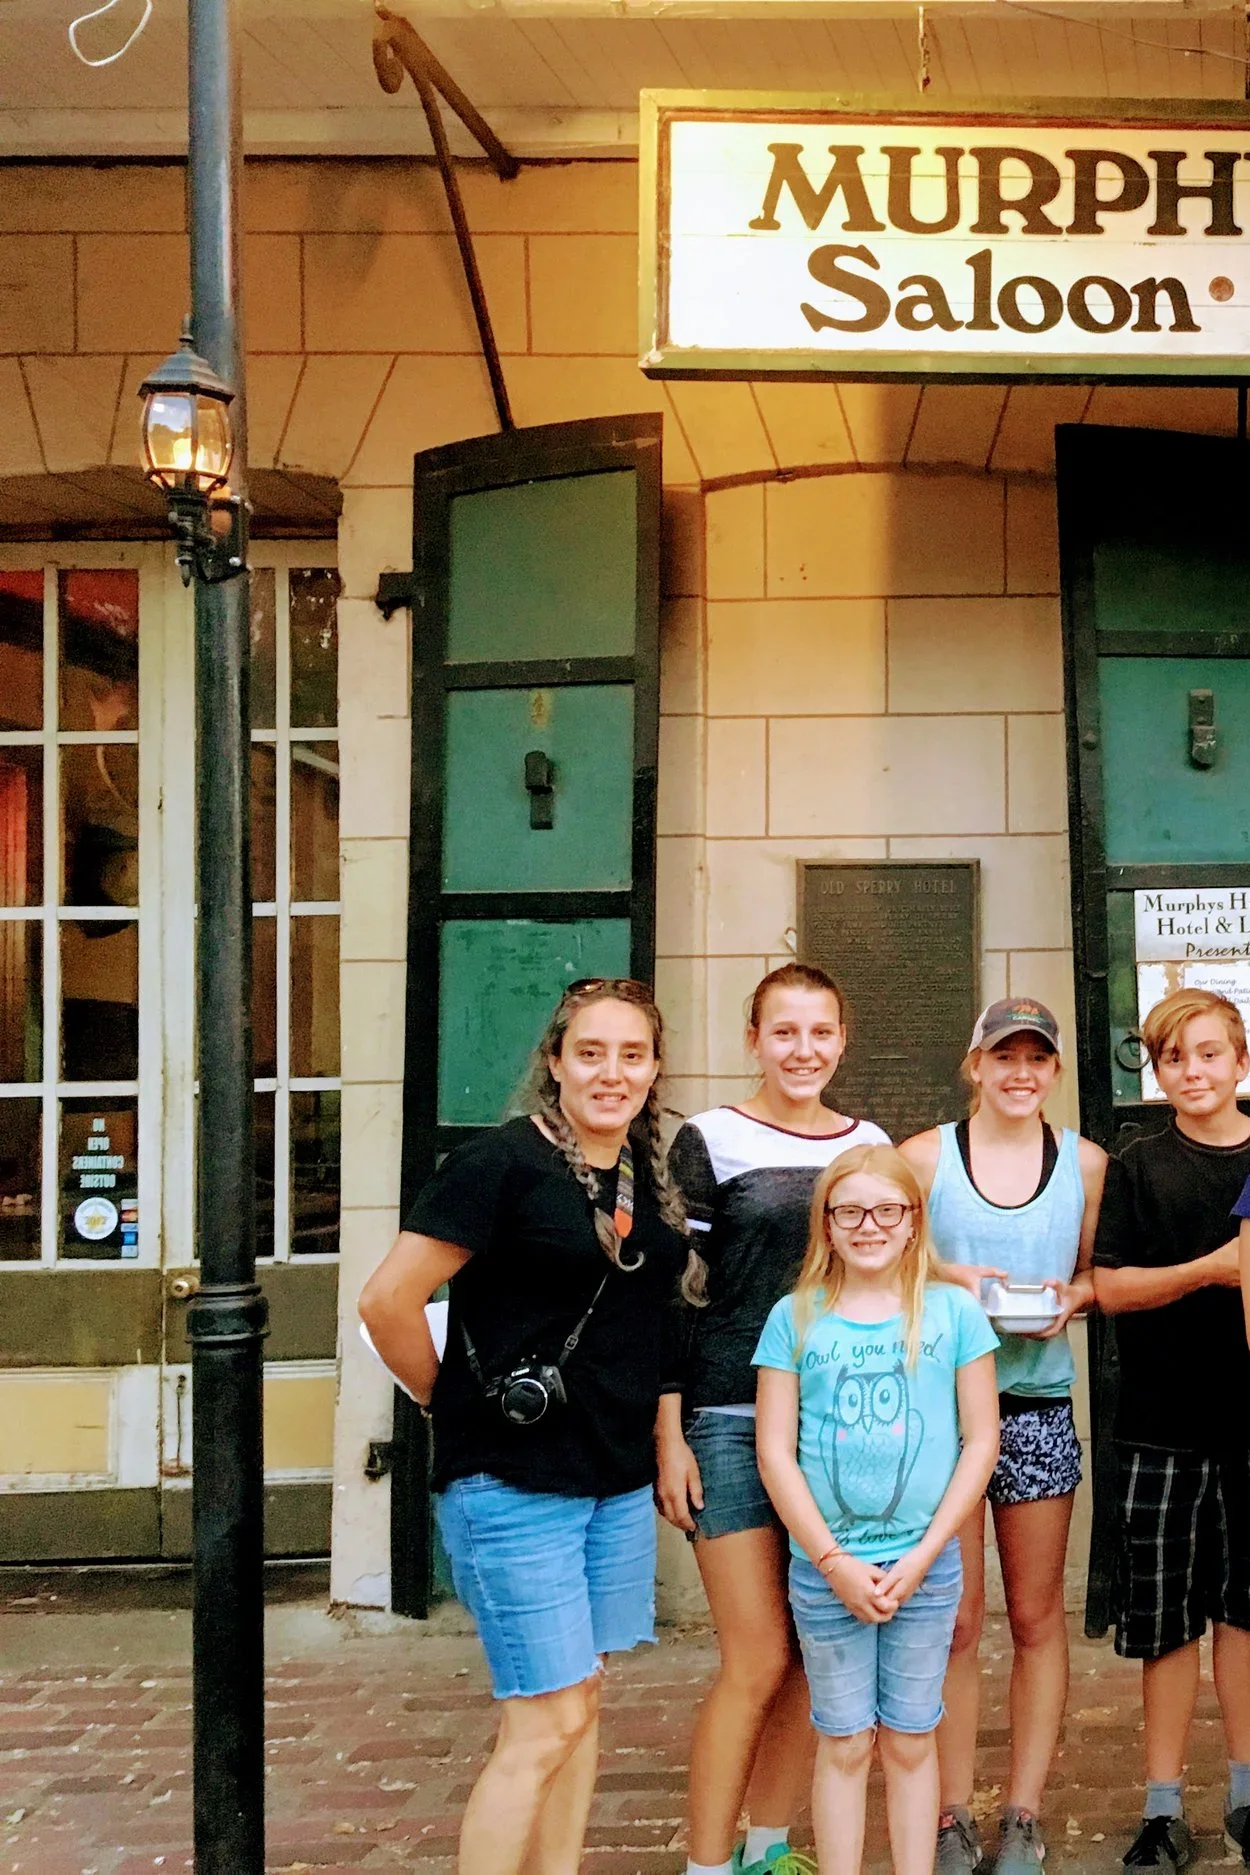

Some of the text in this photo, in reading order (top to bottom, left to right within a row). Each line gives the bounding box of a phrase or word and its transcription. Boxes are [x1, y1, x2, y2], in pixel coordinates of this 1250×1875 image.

[800, 243, 1202, 334] Saloon
[820, 878, 957, 895] OLD SPERRY HOTEL
[1143, 893, 1224, 915] Murphys
[1157, 917, 1209, 936] Hotel
[1215, 916, 1233, 935] &
[1210, 978, 1237, 987] Dining
[805, 1340, 841, 1369] Owl
[851, 1344, 886, 1368] you
